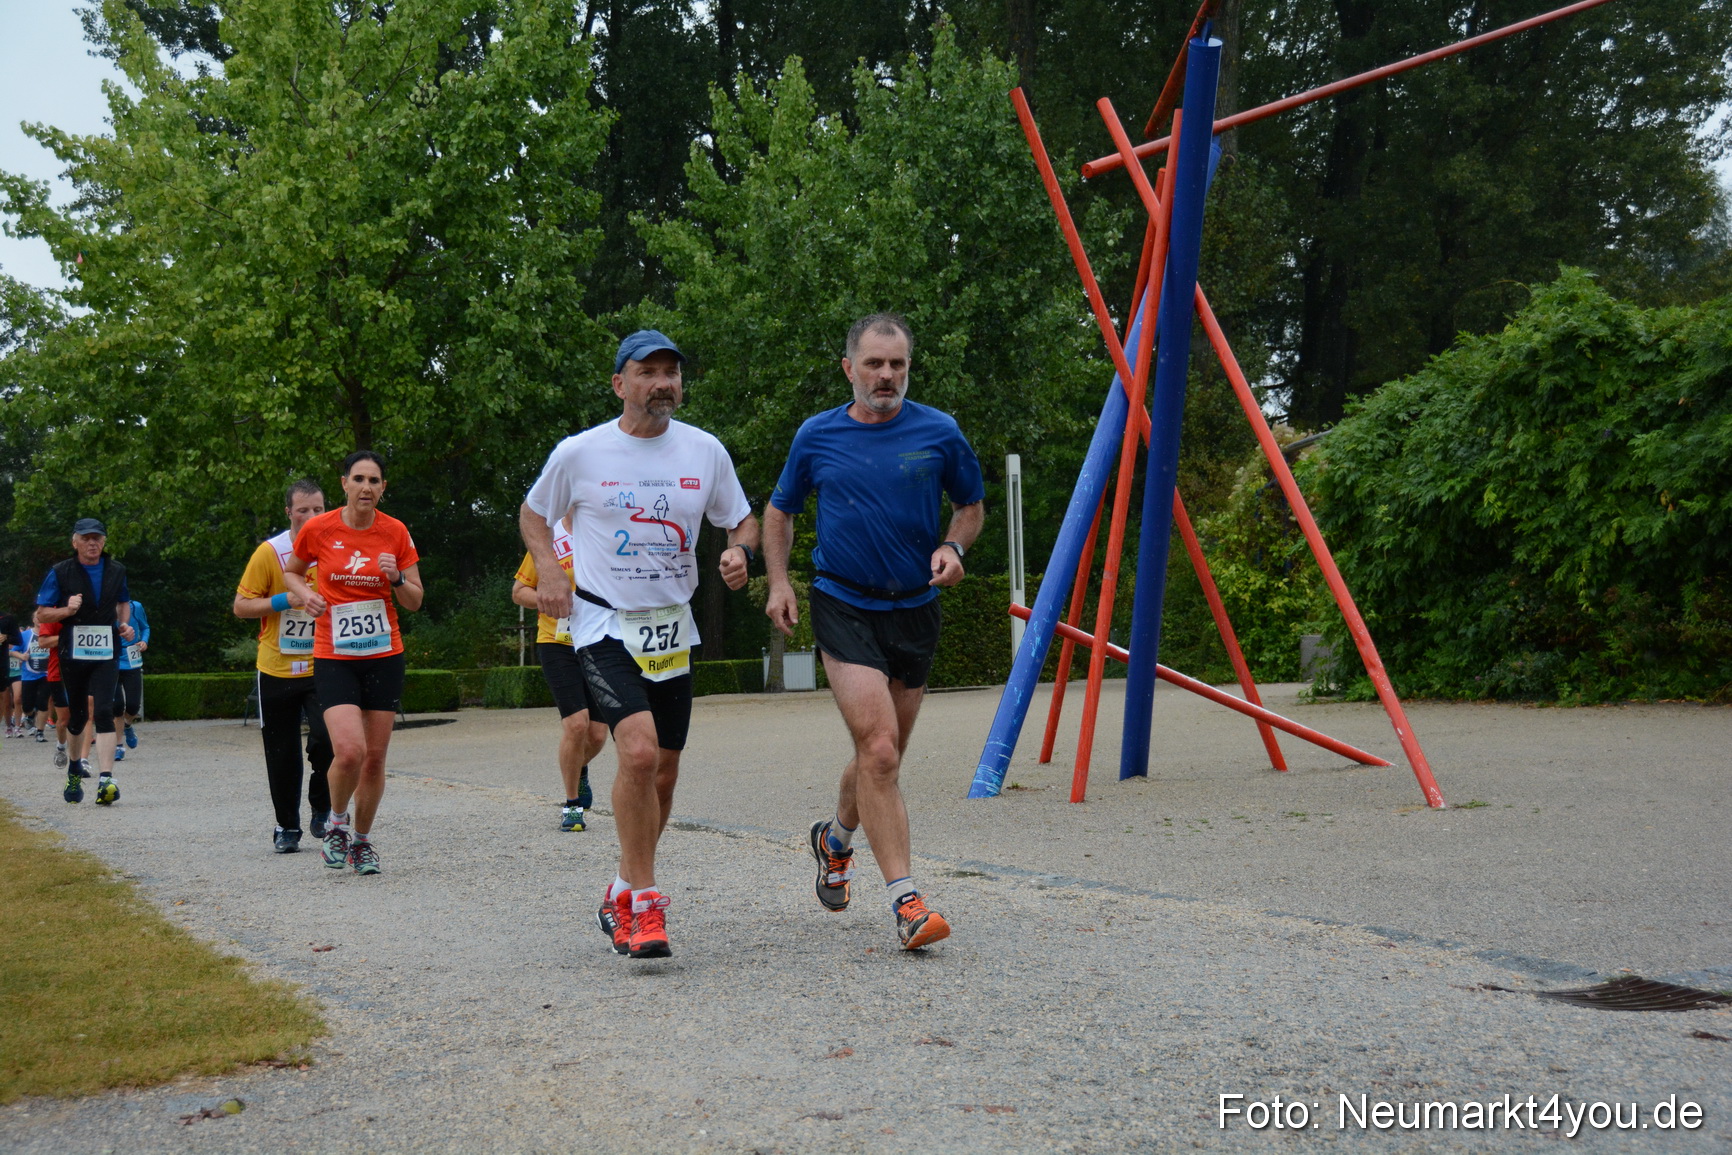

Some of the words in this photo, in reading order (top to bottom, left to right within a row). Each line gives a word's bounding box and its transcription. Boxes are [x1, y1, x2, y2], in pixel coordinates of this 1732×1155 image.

[330, 573, 380, 582] funrunners
[344, 580, 385, 588] neumarkt
[338, 613, 385, 638] 2531
[78, 634, 109, 647] 2021
[639, 621, 680, 653] 252
[290, 640, 315, 648] Christi
[350, 639, 379, 649] Claudia
[648, 656, 675, 671] Rudolf
